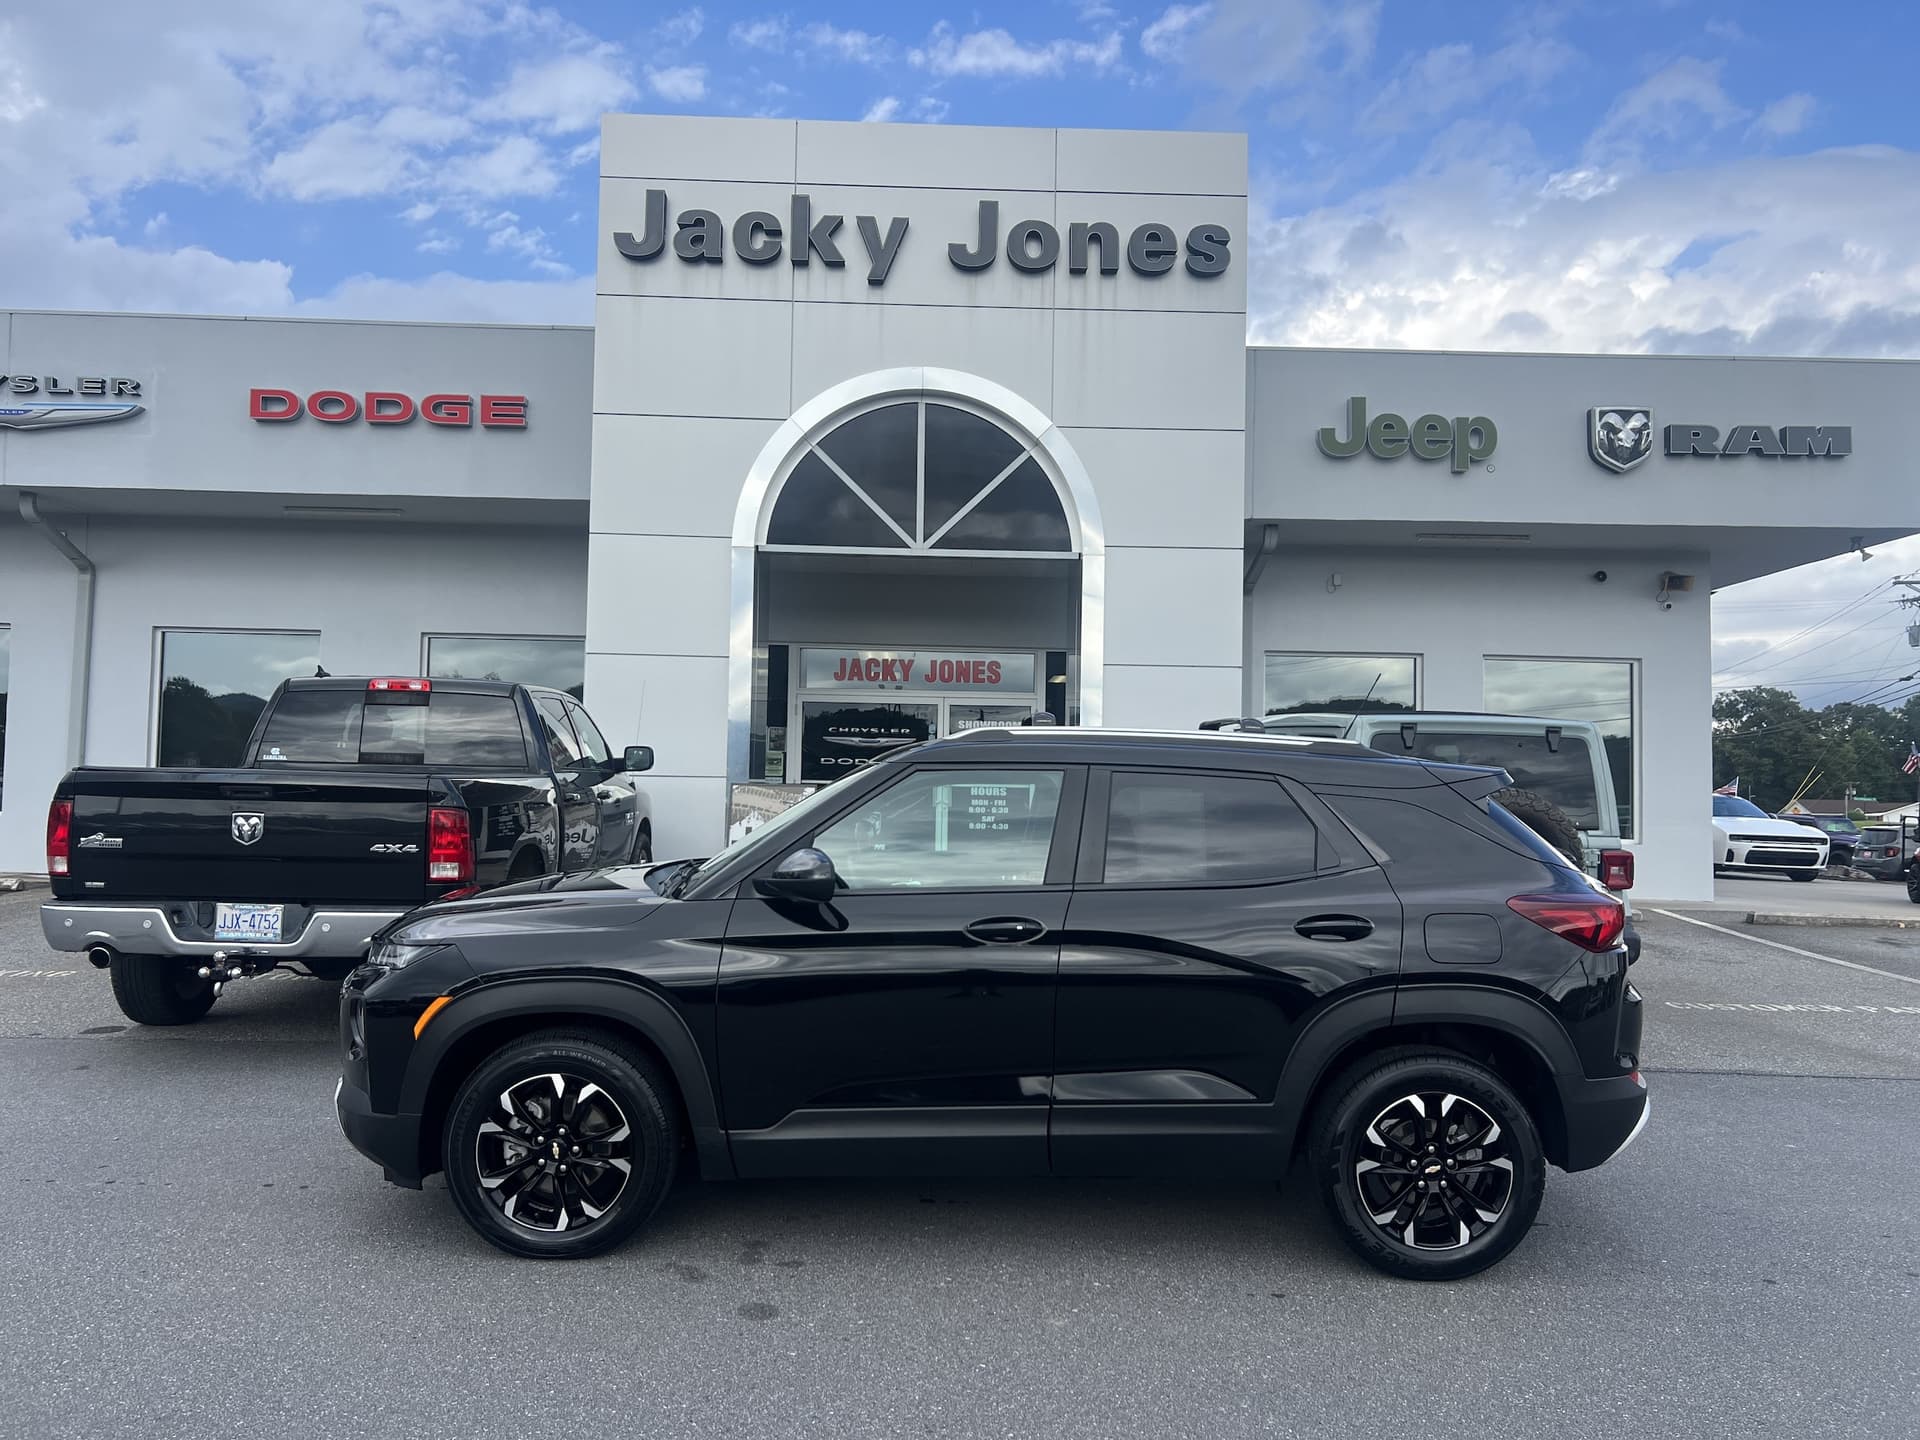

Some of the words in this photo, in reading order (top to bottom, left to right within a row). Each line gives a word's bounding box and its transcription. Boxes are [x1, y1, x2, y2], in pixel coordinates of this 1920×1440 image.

[612, 189, 909, 286] Jacky
[948, 200, 1232, 276] Jones
[250, 388, 528, 428] DODGE
[1316, 396, 1498, 474] Jeep
[1664, 424, 1852, 458] RAM
[833, 657, 915, 682] JACKY
[924, 659, 1002, 684] JONES
[958, 720, 1022, 729] SHOWROOM
[820, 757, 881, 765] DOD
[970, 787, 1007, 796] HOURS
[218, 913, 279, 930] JJX-4752
